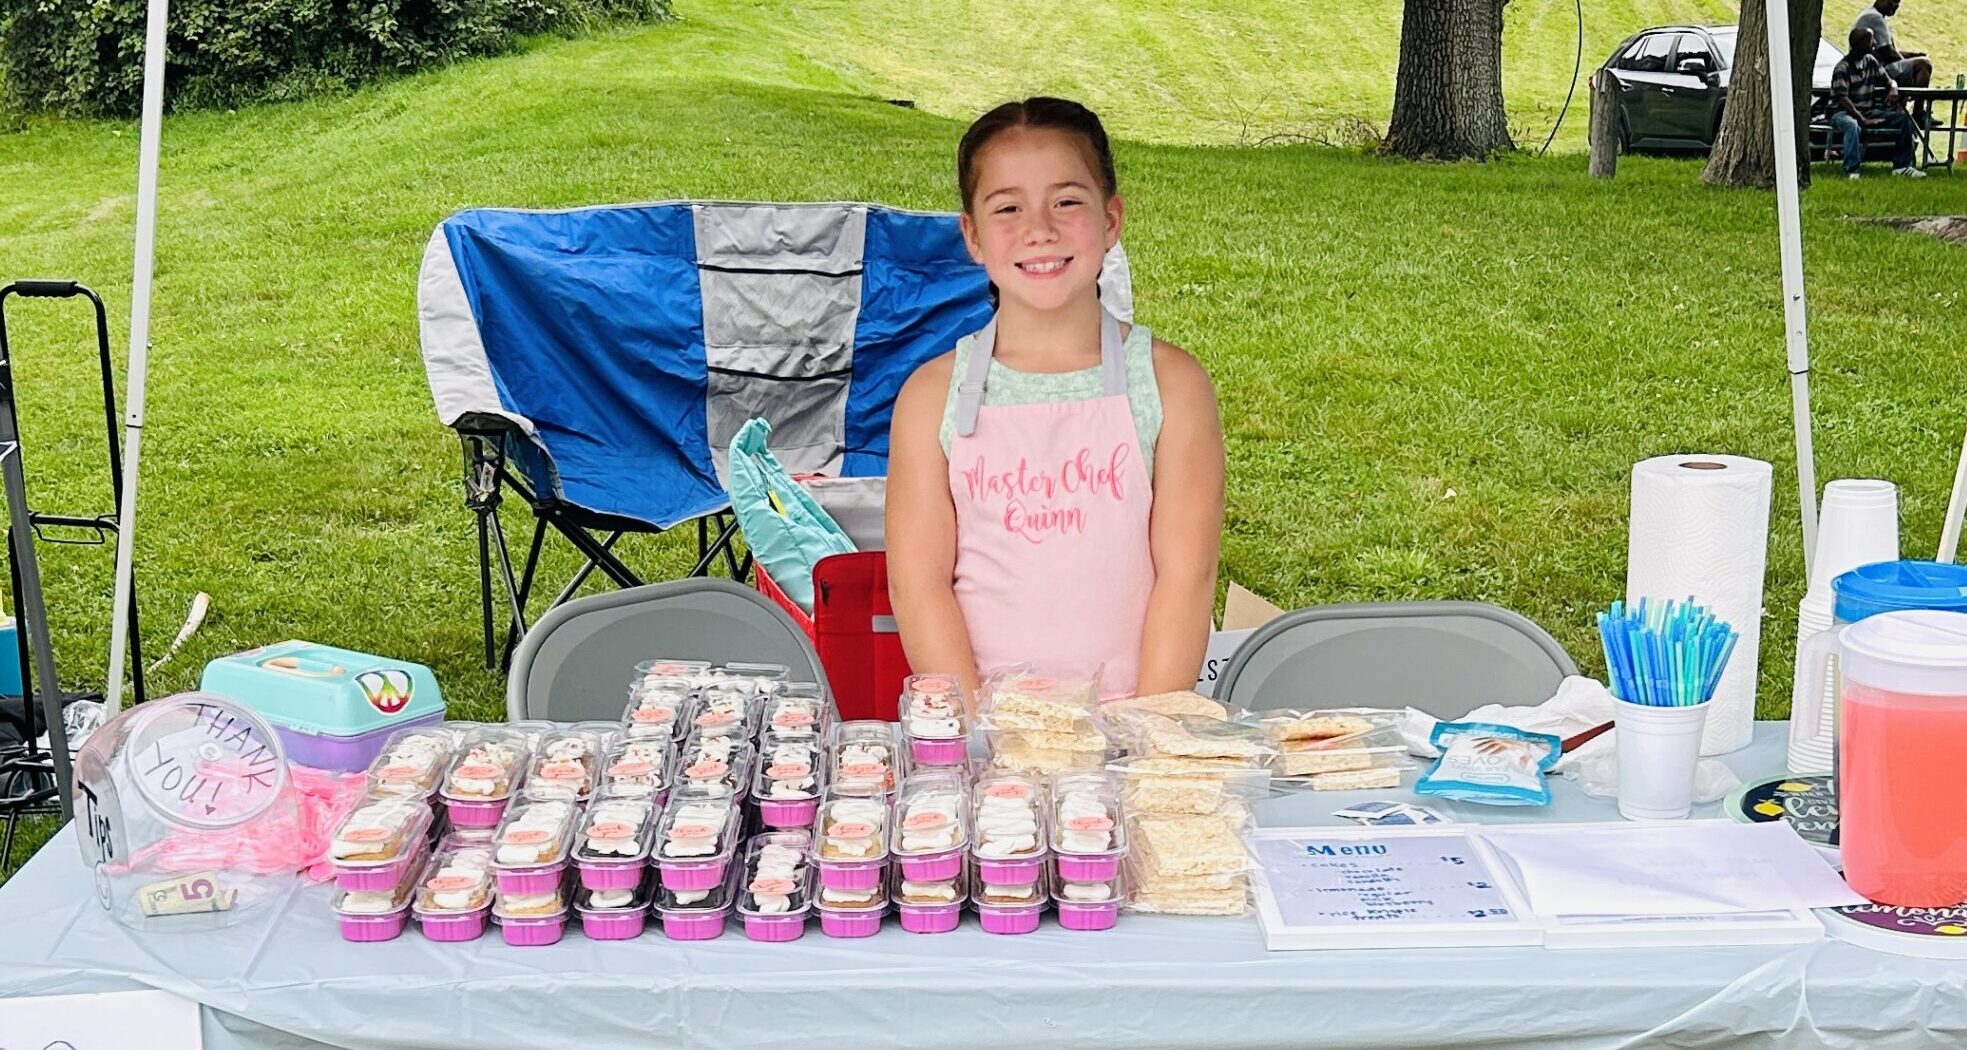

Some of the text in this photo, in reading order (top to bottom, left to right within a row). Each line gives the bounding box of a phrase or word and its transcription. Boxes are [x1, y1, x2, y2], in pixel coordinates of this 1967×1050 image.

[962, 442, 1130, 503] Master Chef
[1003, 498, 1087, 544] Quinn
[184, 702, 278, 794] THANK
[78, 780, 113, 864] Tips
[1306, 844, 1387, 856] Menu
[180, 878, 214, 901] 5
